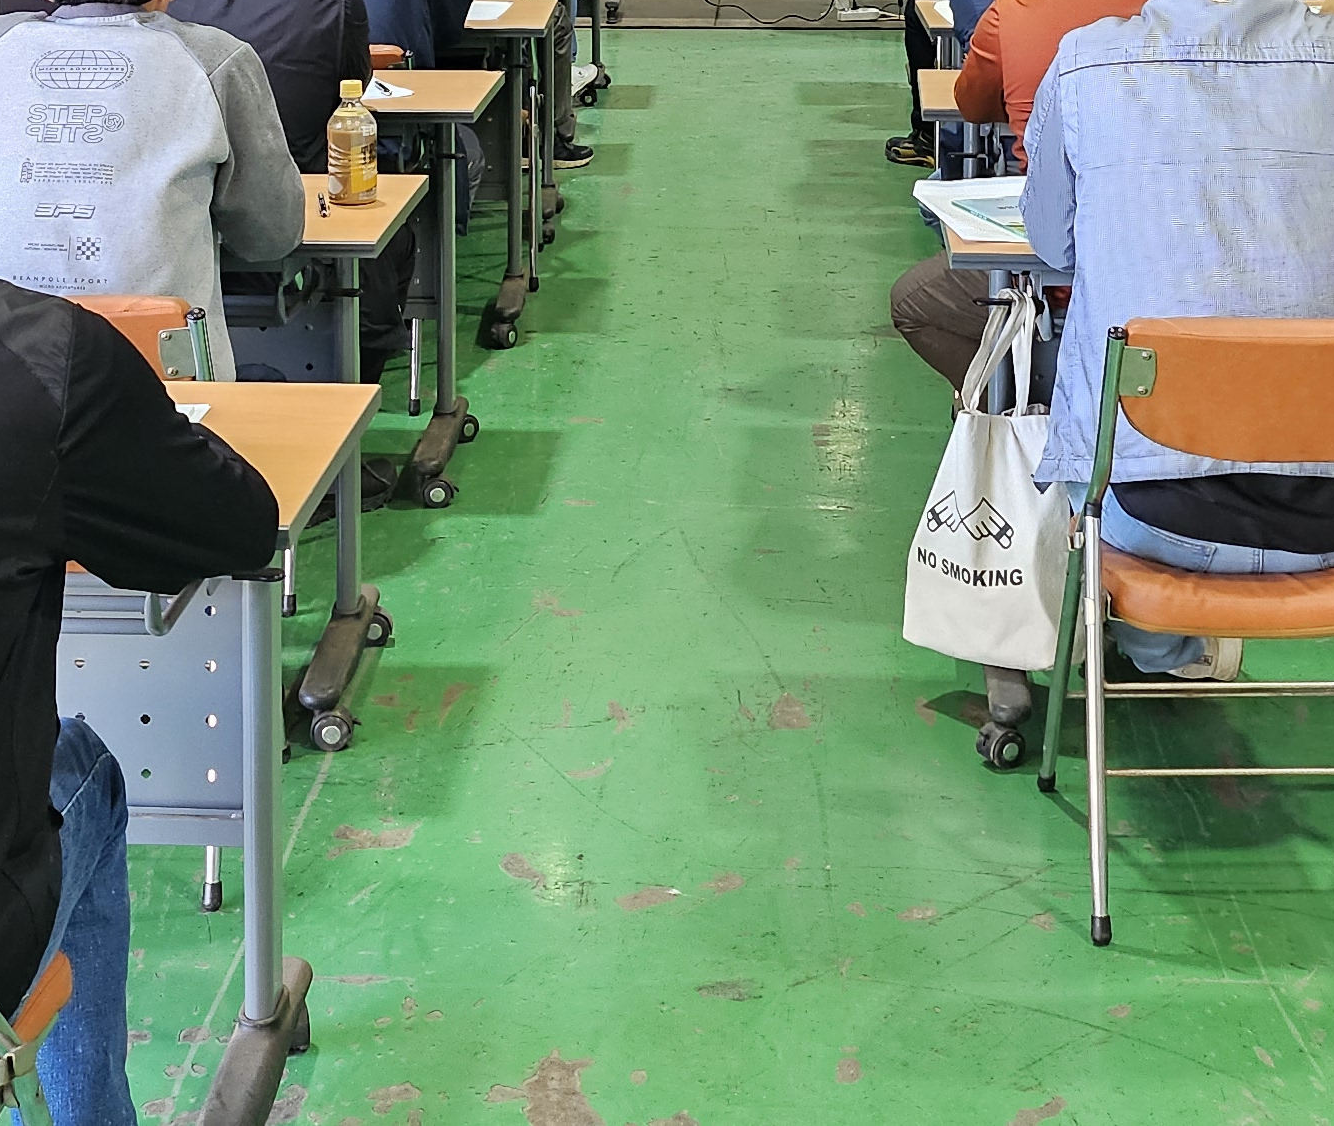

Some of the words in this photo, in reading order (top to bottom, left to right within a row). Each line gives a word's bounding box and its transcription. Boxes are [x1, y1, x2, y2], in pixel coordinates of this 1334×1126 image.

[27, 104, 108, 124] STEP
[12, 275, 67, 283] BEANPOLE
[917, 546, 937, 569] NO
[941, 559, 1024, 587] SMOKING
